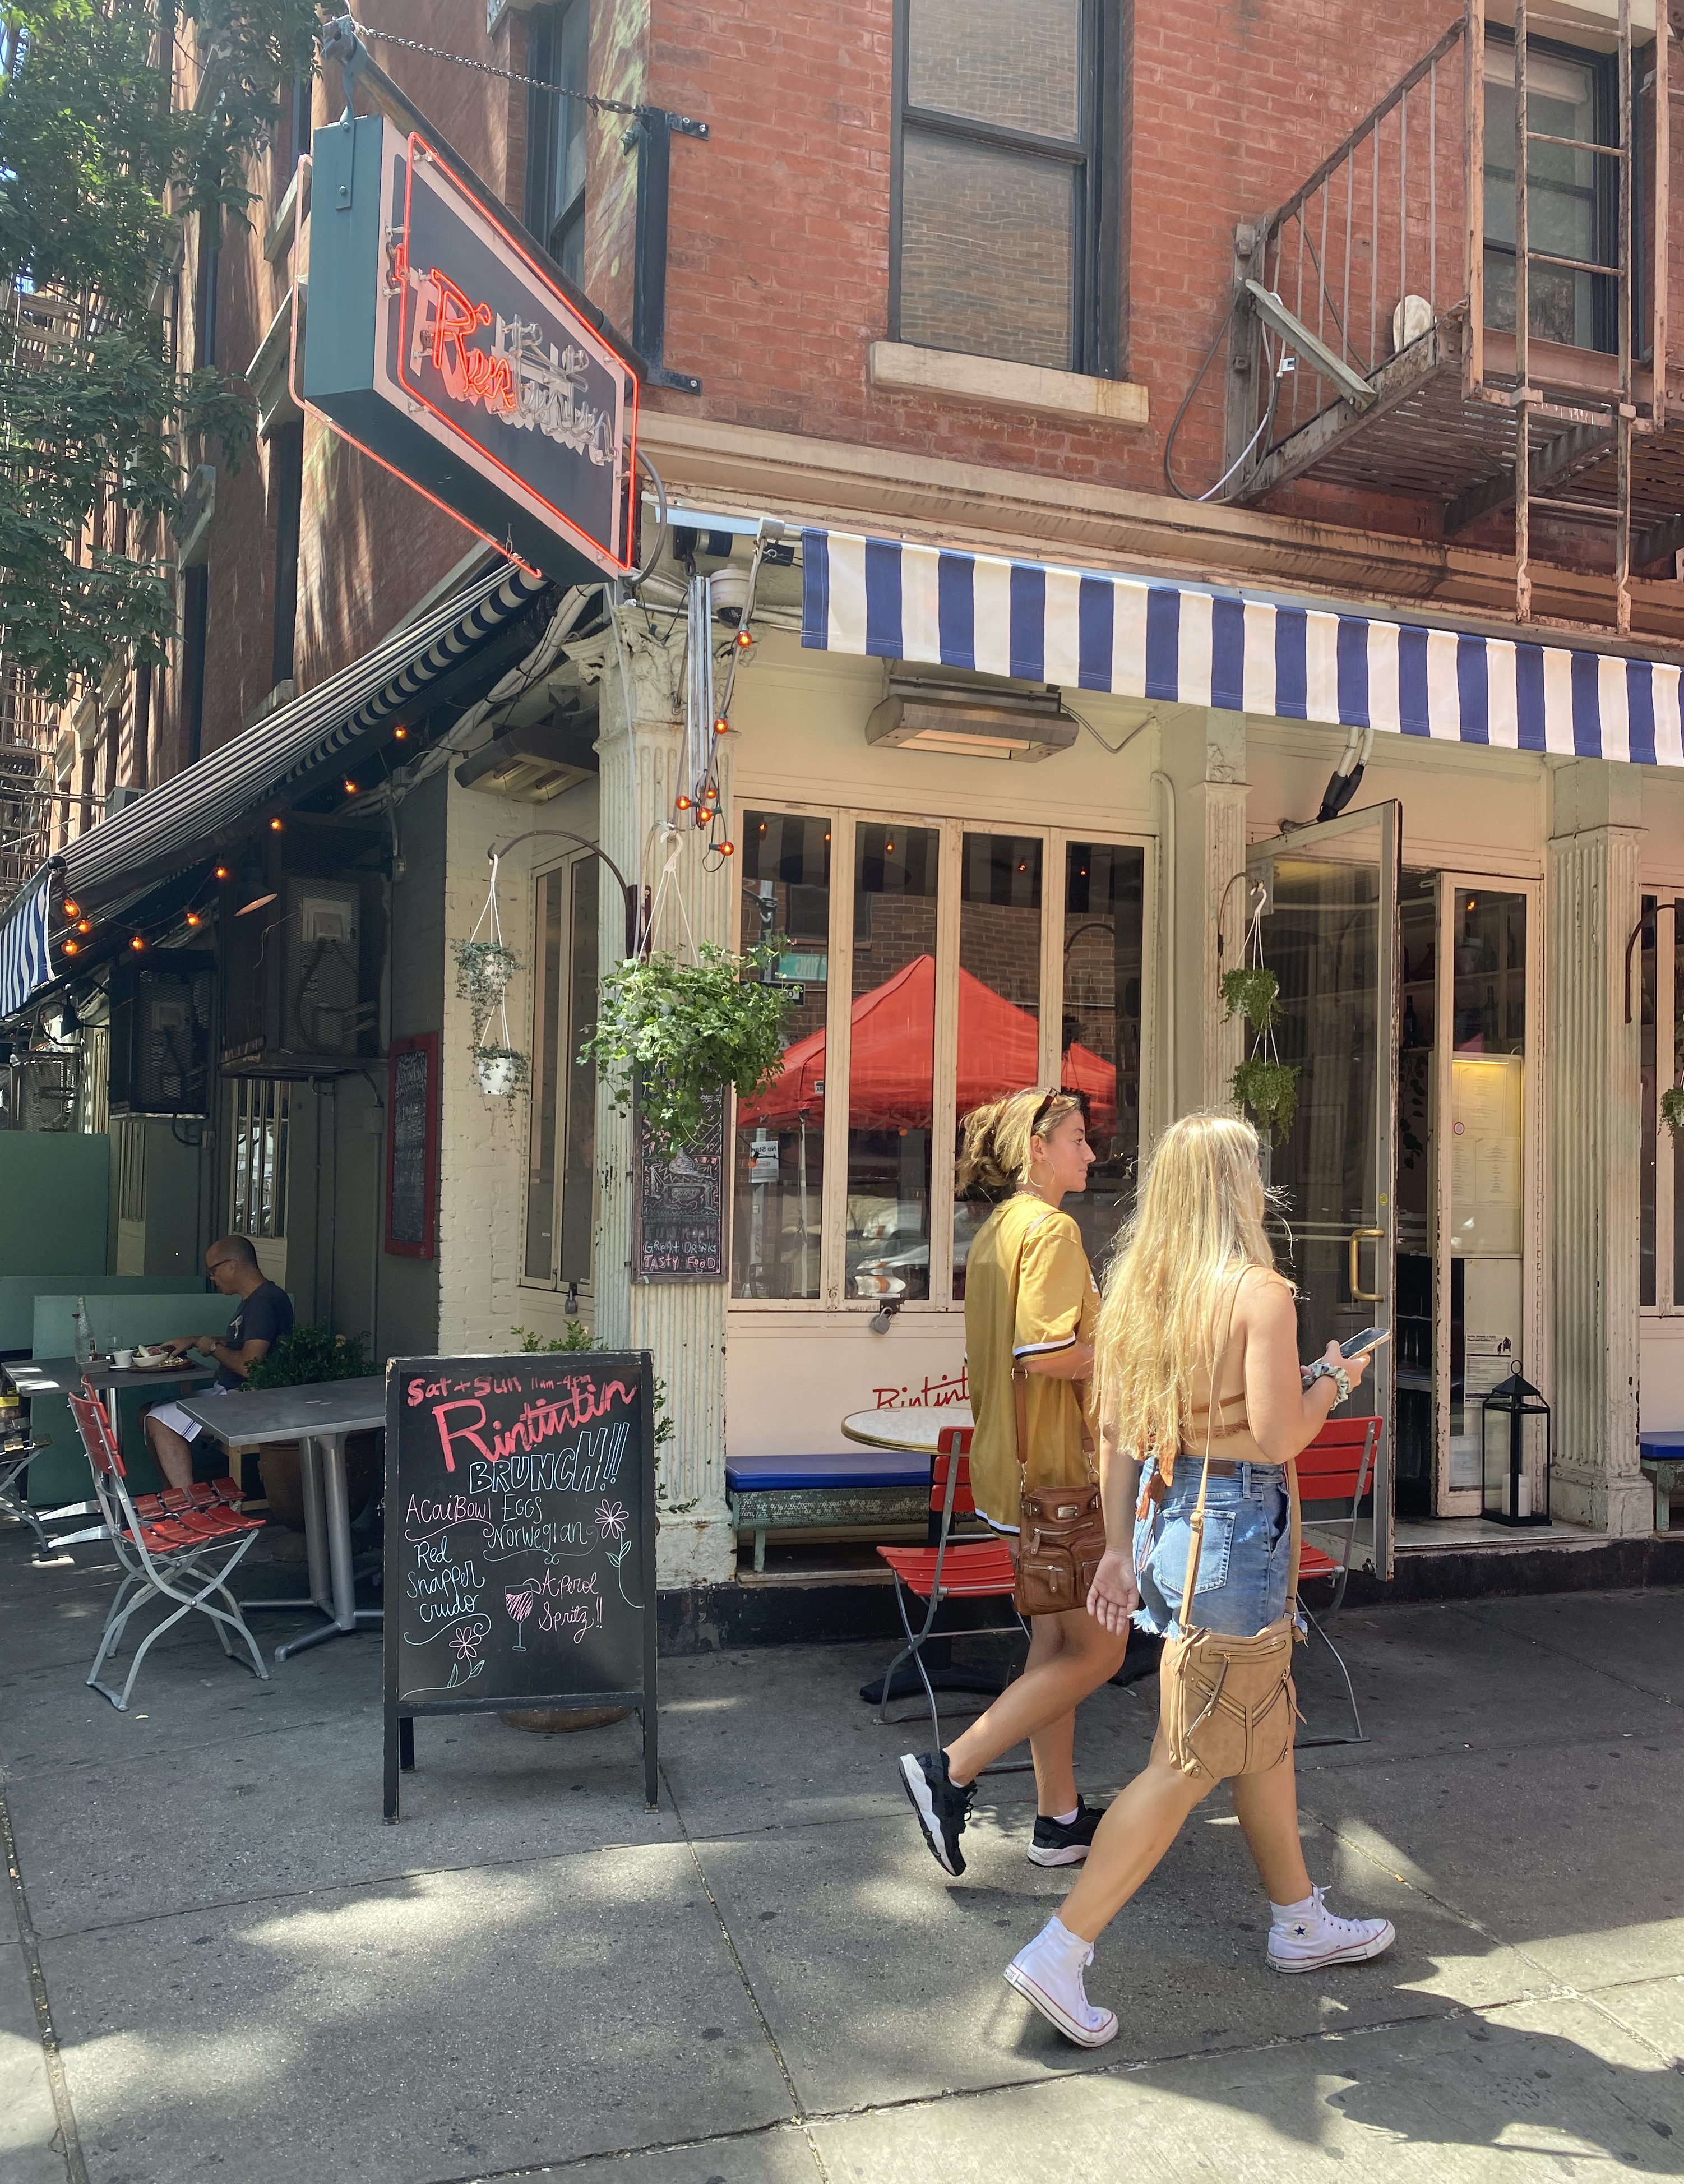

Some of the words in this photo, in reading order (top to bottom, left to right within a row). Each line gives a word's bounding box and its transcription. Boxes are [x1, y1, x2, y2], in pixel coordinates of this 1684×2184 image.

[407, 1377, 452, 1407] Sat
[474, 1374, 522, 1397] Sun
[873, 1366, 970, 1409] Rintint
[432, 1380, 638, 1472] Rintintin
[414, 1535, 454, 1571] Red
[488, 1518, 587, 1552] Norwegian
[407, 1560, 485, 1599] Snapper
